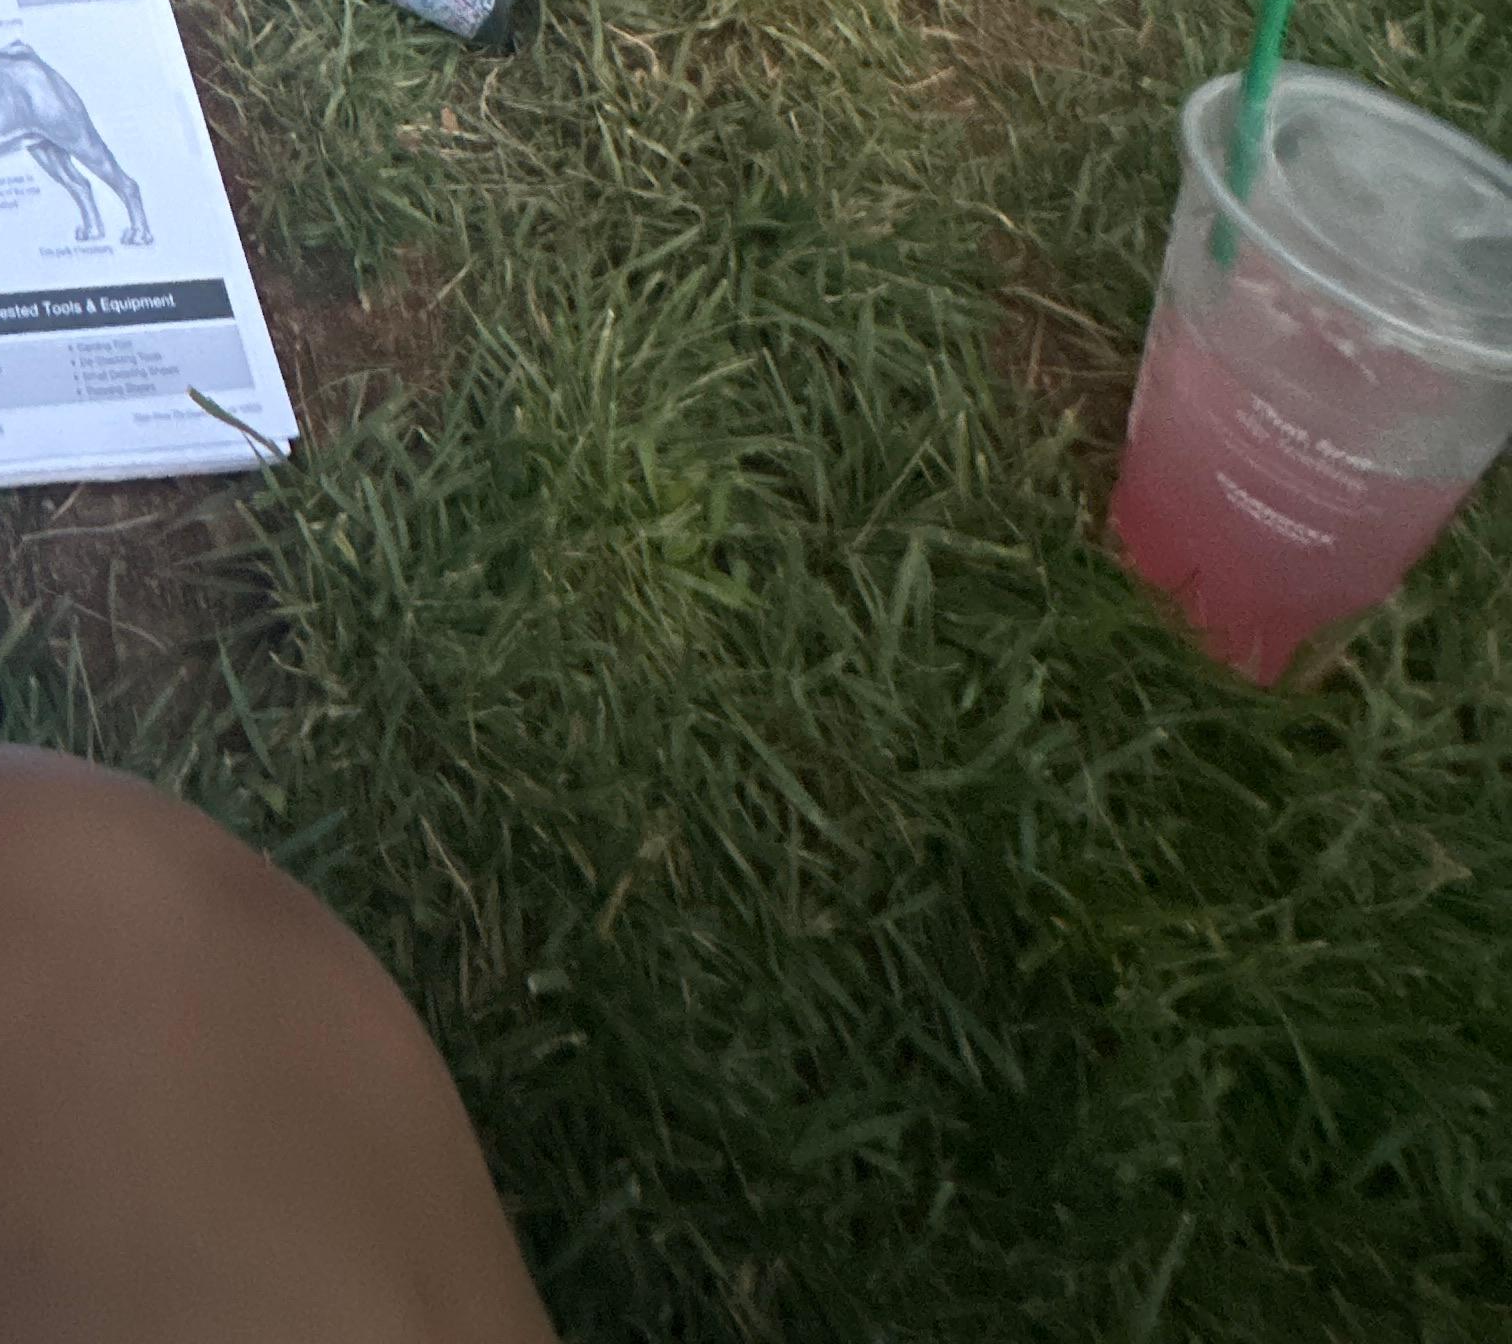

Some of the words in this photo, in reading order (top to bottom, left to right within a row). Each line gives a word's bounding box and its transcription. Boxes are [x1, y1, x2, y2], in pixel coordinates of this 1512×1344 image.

[42, 299, 82, 317] Tools
[86, 297, 98, 313] &
[99, 292, 177, 314] Equipment
